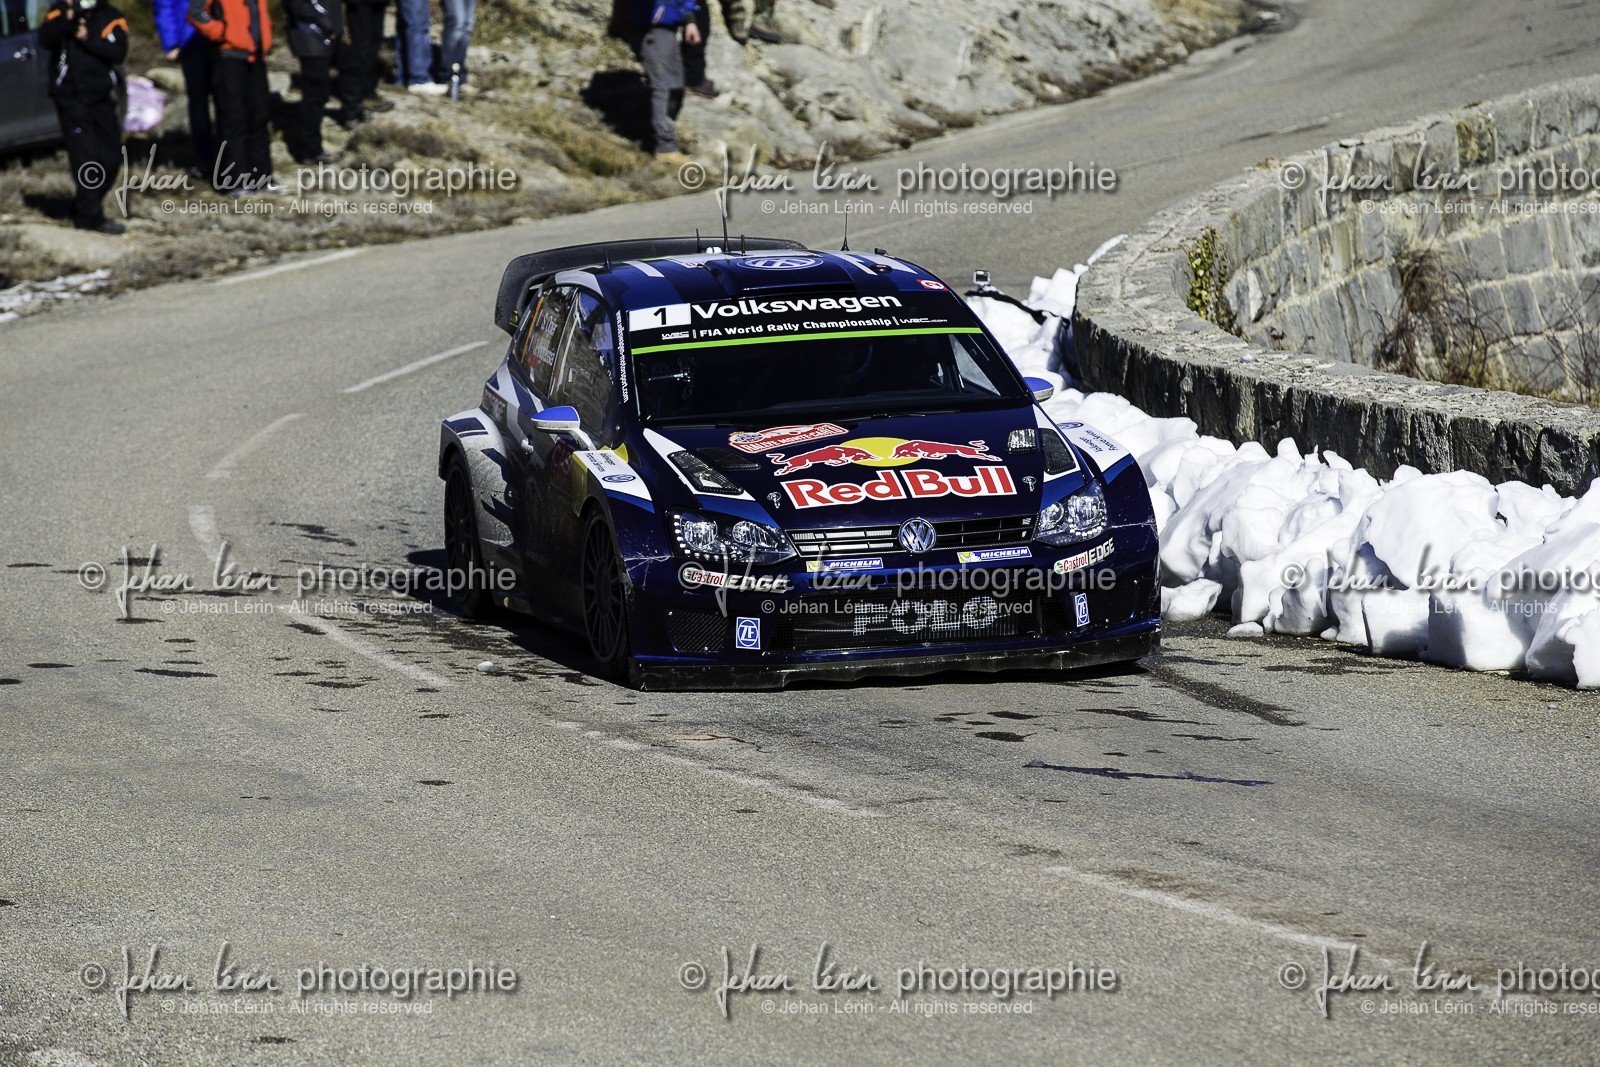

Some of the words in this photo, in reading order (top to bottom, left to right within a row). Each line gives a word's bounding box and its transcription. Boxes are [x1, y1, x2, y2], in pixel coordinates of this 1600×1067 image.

[653, 307, 667, 326] 1
[691, 294, 903, 320] Volkswagen
[699, 328, 723, 338] FIA
[724, 324, 764, 335] World
[767, 321, 801, 334] Rally
[802, 317, 892, 329] Championship
[782, 470, 905, 508] Red
[902, 467, 1016, 498] Bull
[828, 559, 881, 568] MICHELIN
[979, 548, 1029, 559] MICHELIN
[1062, 552, 1089, 572] Castrol
[1089, 537, 1115, 565] EDGE
[691, 570, 724, 586] Castrol
[726, 574, 788, 593] EDGE
[852, 596, 998, 637] POLO
[738, 622, 759, 645] ZF
